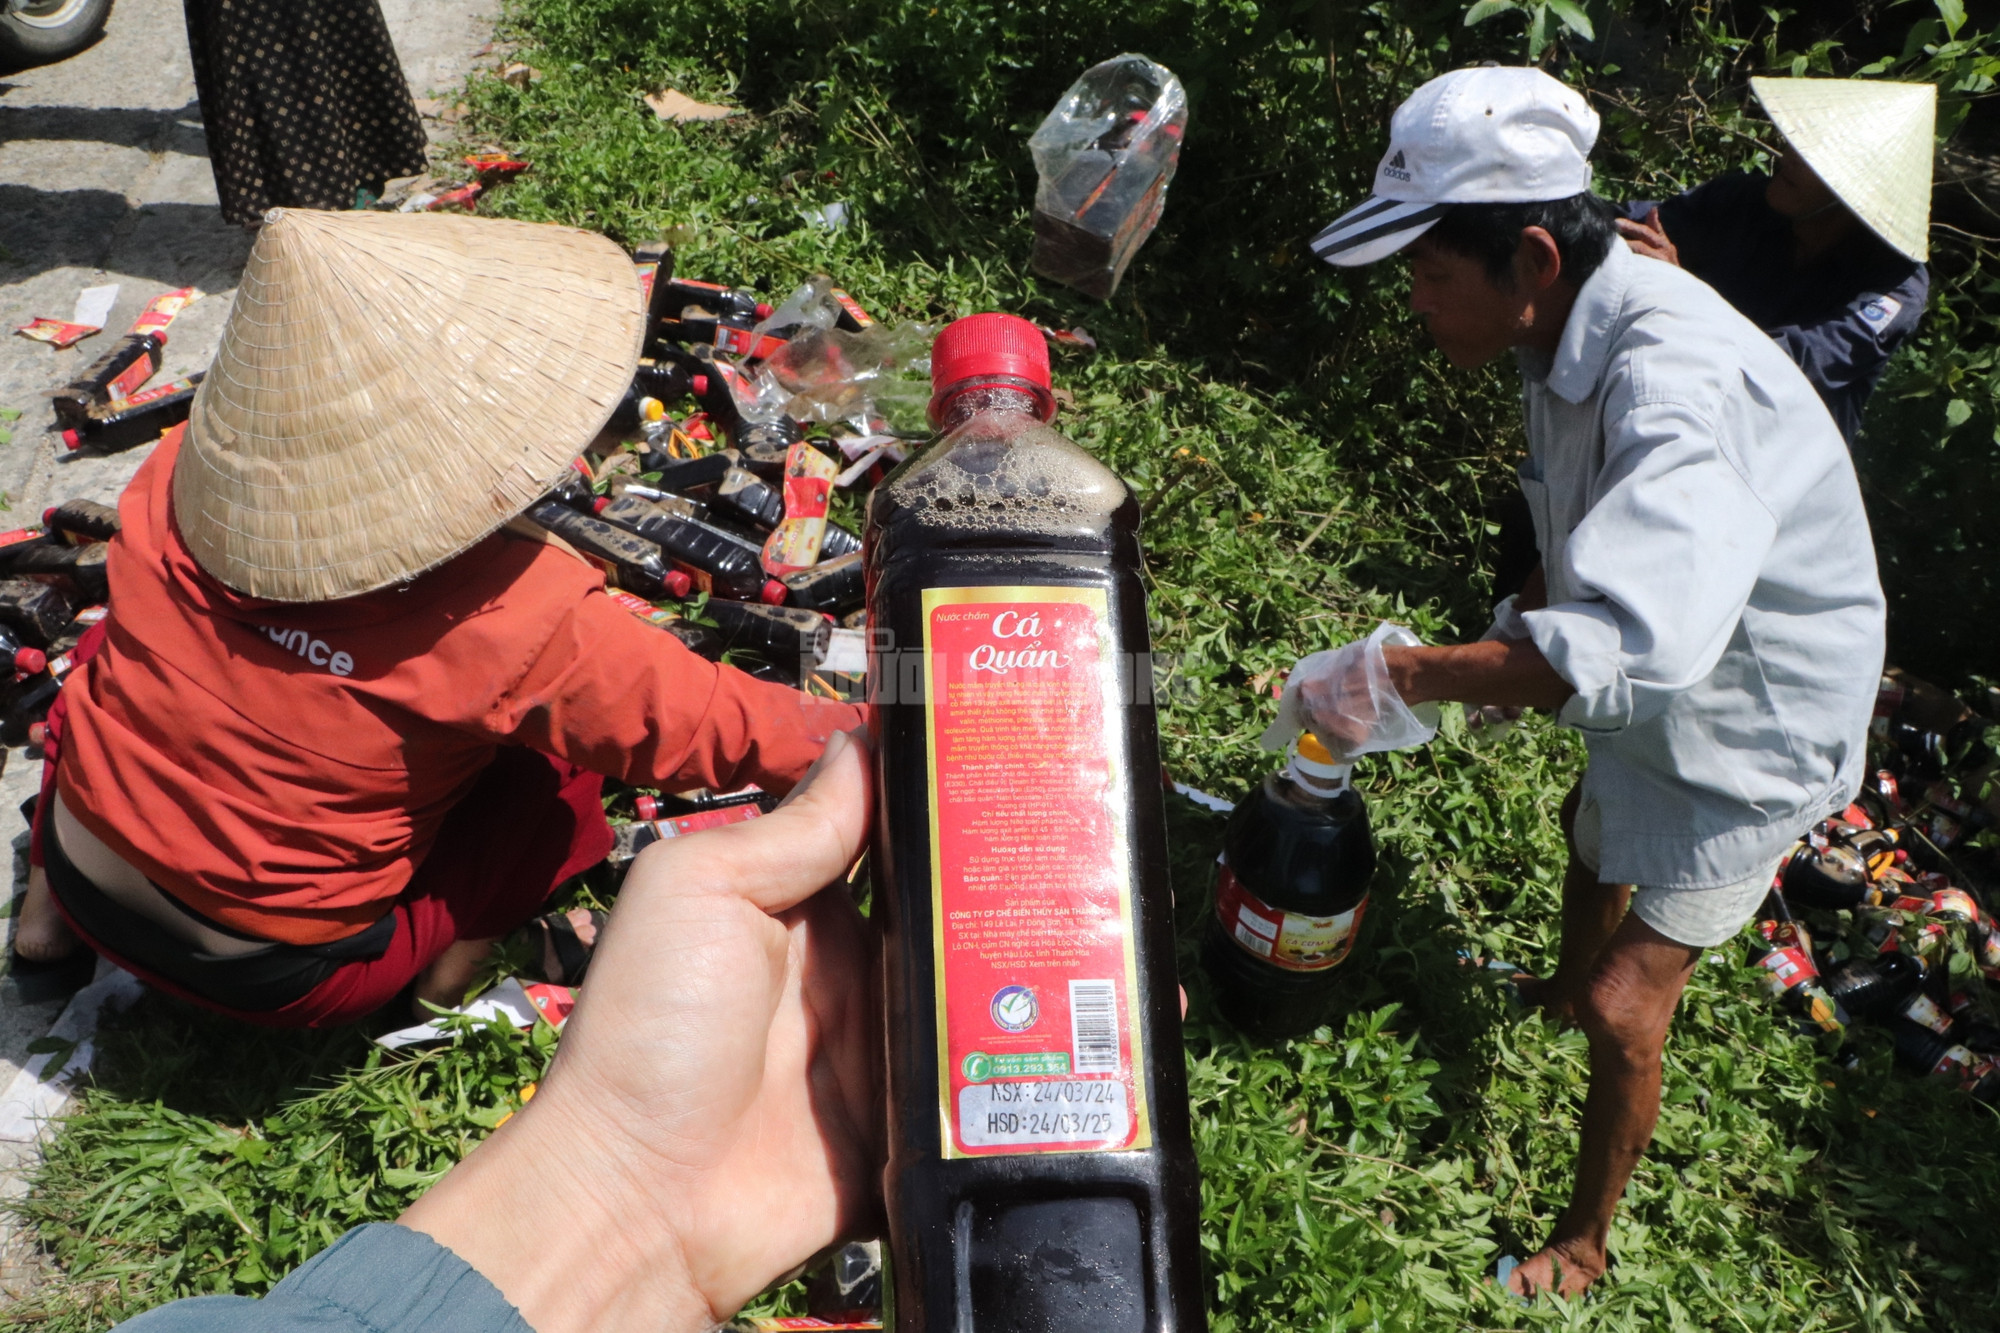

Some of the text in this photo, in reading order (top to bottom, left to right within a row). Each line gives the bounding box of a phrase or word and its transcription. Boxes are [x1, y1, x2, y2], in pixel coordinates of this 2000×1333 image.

[1384, 167, 1411, 182] adidas
[936, 613, 961, 622] Nước
[992, 610, 1043, 639] Cá
[950, 910, 971, 919] CÔNG
[973, 910, 982, 918] TY
[984, 910, 995, 918] CP
[996, 908, 1012, 917] CHẾ
[980, 920, 993, 928] 149
[959, 932, 968, 940] SX
[991, 1082, 1114, 1103] NSX:24/03/24
[987, 1113, 1112, 1134] HSD:24/03/25
